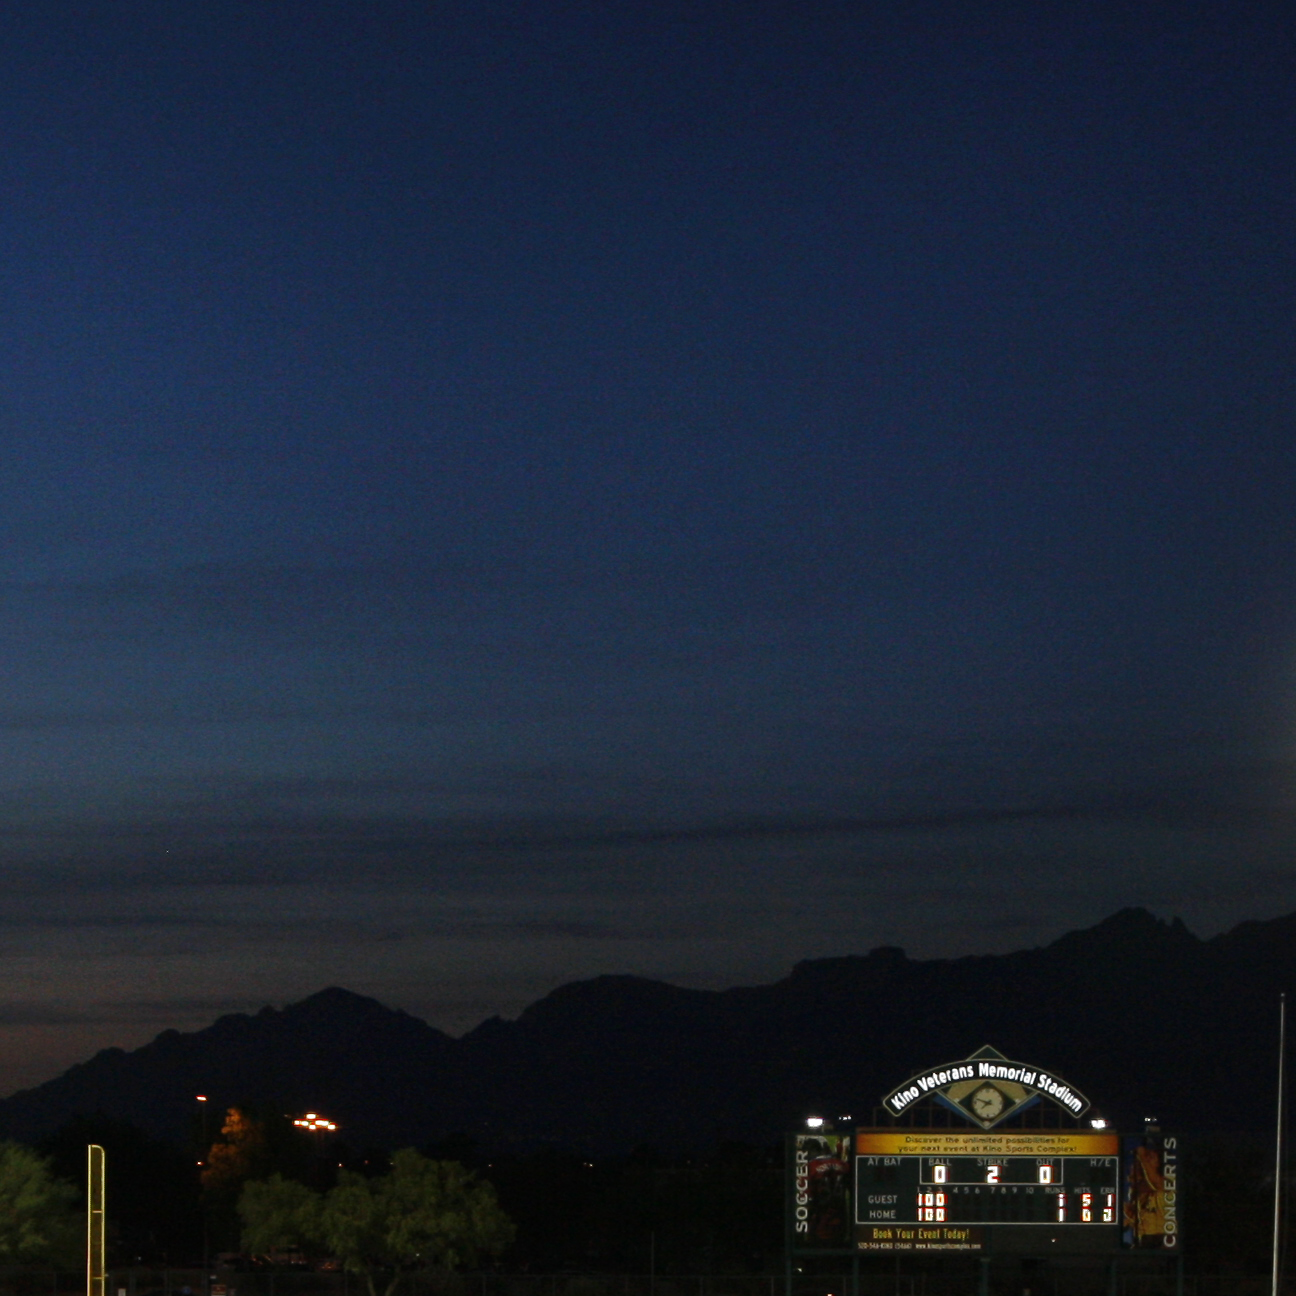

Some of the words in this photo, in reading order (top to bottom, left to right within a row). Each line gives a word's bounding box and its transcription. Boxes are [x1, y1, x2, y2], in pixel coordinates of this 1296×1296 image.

[891, 1086, 920, 1110] Kino
[917, 1064, 974, 1092] Veterans
[978, 1062, 1036, 1086] Memorial
[1037, 1074, 1083, 1113] Stadium
[905, 1136, 941, 1144] Discover
[945, 1136, 960, 1144] the
[962, 1136, 1003, 1144] unlimited
[1006, 1136, 1055, 1145] possibilities
[1057, 1136, 1070, 1144] for
[898, 1146, 917, 1154] your
[921, 1145, 940, 1153] next
[943, 1145, 968, 1153] event
[971, 1145, 980, 1153] at
[982, 1145, 1002, 1153] Kino
[1006, 1145, 1034, 1154] Sports
[867, 1158, 880, 1167] AT
[883, 1158, 903, 1167] BAT
[928, 1158, 952, 1167] BALL
[976, 1158, 1010, 1167] STRIKE
[1035, 1158, 1055, 1167] OUT
[1090, 1158, 1112, 1168] H/E
[933, 1165, 948, 1184] 0
[985, 1165, 1001, 1184] 2
[1038, 1165, 1054, 1184] 0
[795, 1150, 809, 1233] SOCCER
[952, 1186, 959, 1195] 4
[963, 1186, 970, 1195] 5
[974, 1186, 981, 1195] 6
[1011, 1186, 1018, 1195] 9
[1025, 1186, 1035, 1195] 10
[1163, 1137, 1177, 1248] CONCERTS
[867, 1194, 898, 1204] GUEST
[869, 1209, 897, 1219] HOME
[872, 1227, 893, 1239] Book
[895, 1227, 915, 1239] Your
[918, 1227, 941, 1239] Event
[943, 1228, 970, 1242] Today!
